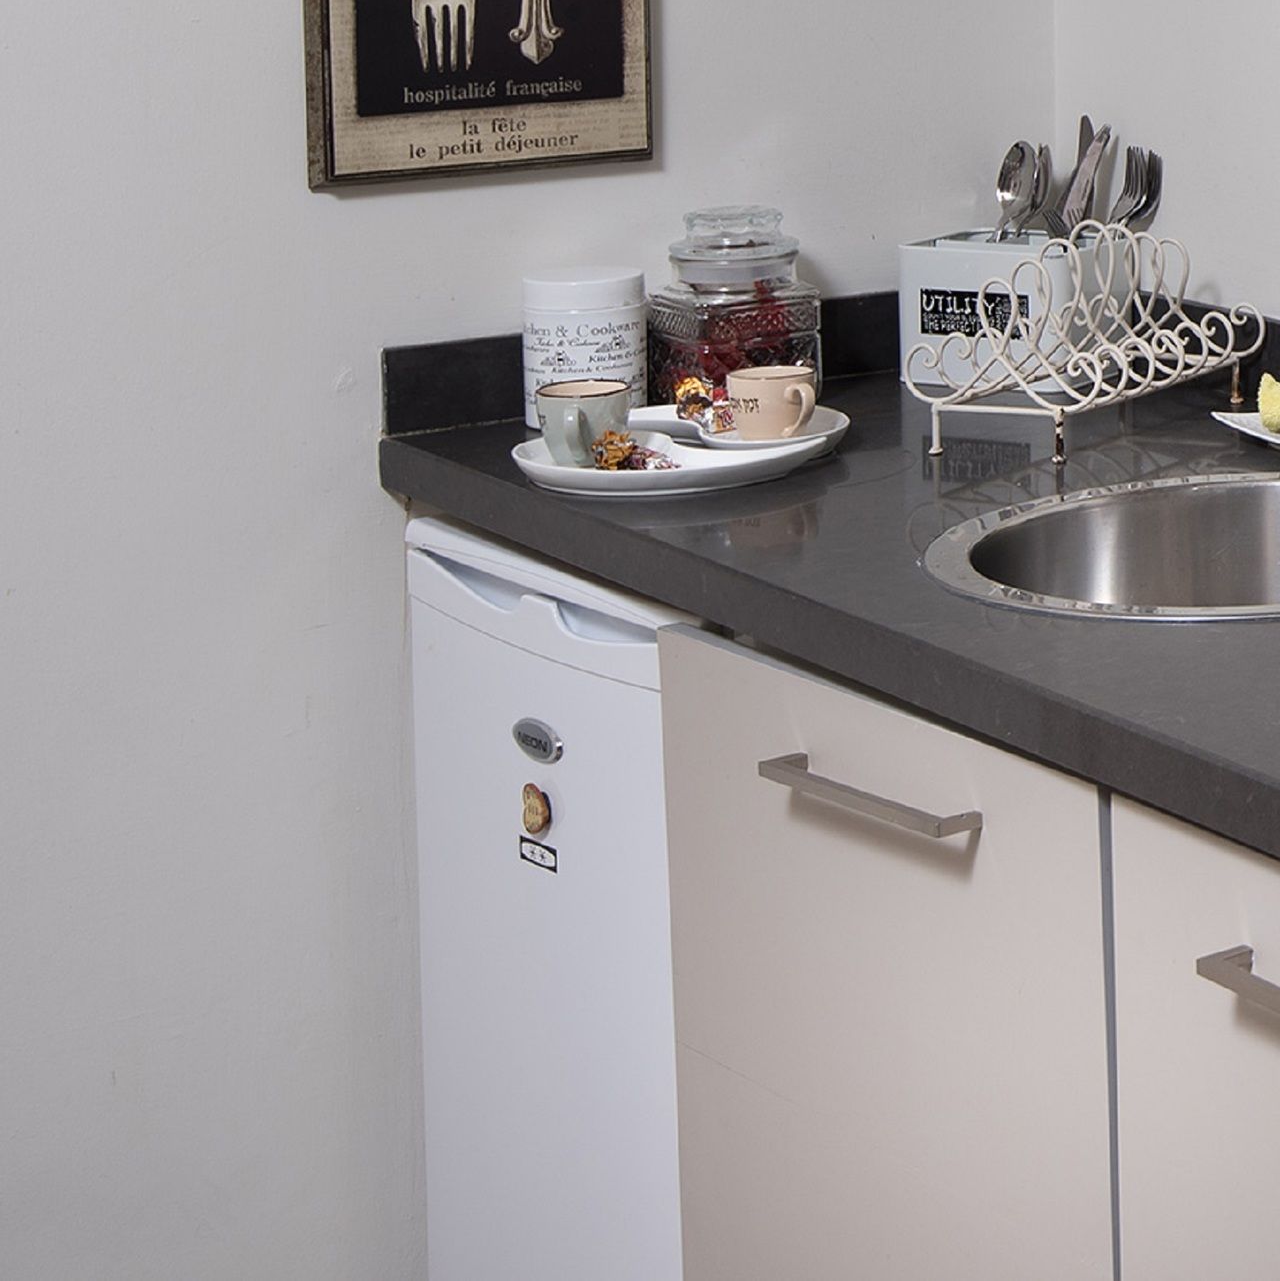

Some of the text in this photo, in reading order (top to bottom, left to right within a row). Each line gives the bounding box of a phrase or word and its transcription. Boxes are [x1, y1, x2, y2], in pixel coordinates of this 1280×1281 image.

[403, 76, 583, 106] hospitalité française
[462, 117, 527, 136] la fête
[409, 133, 579, 161] le petit déjeuner
[518, 731, 548, 754] NEON
